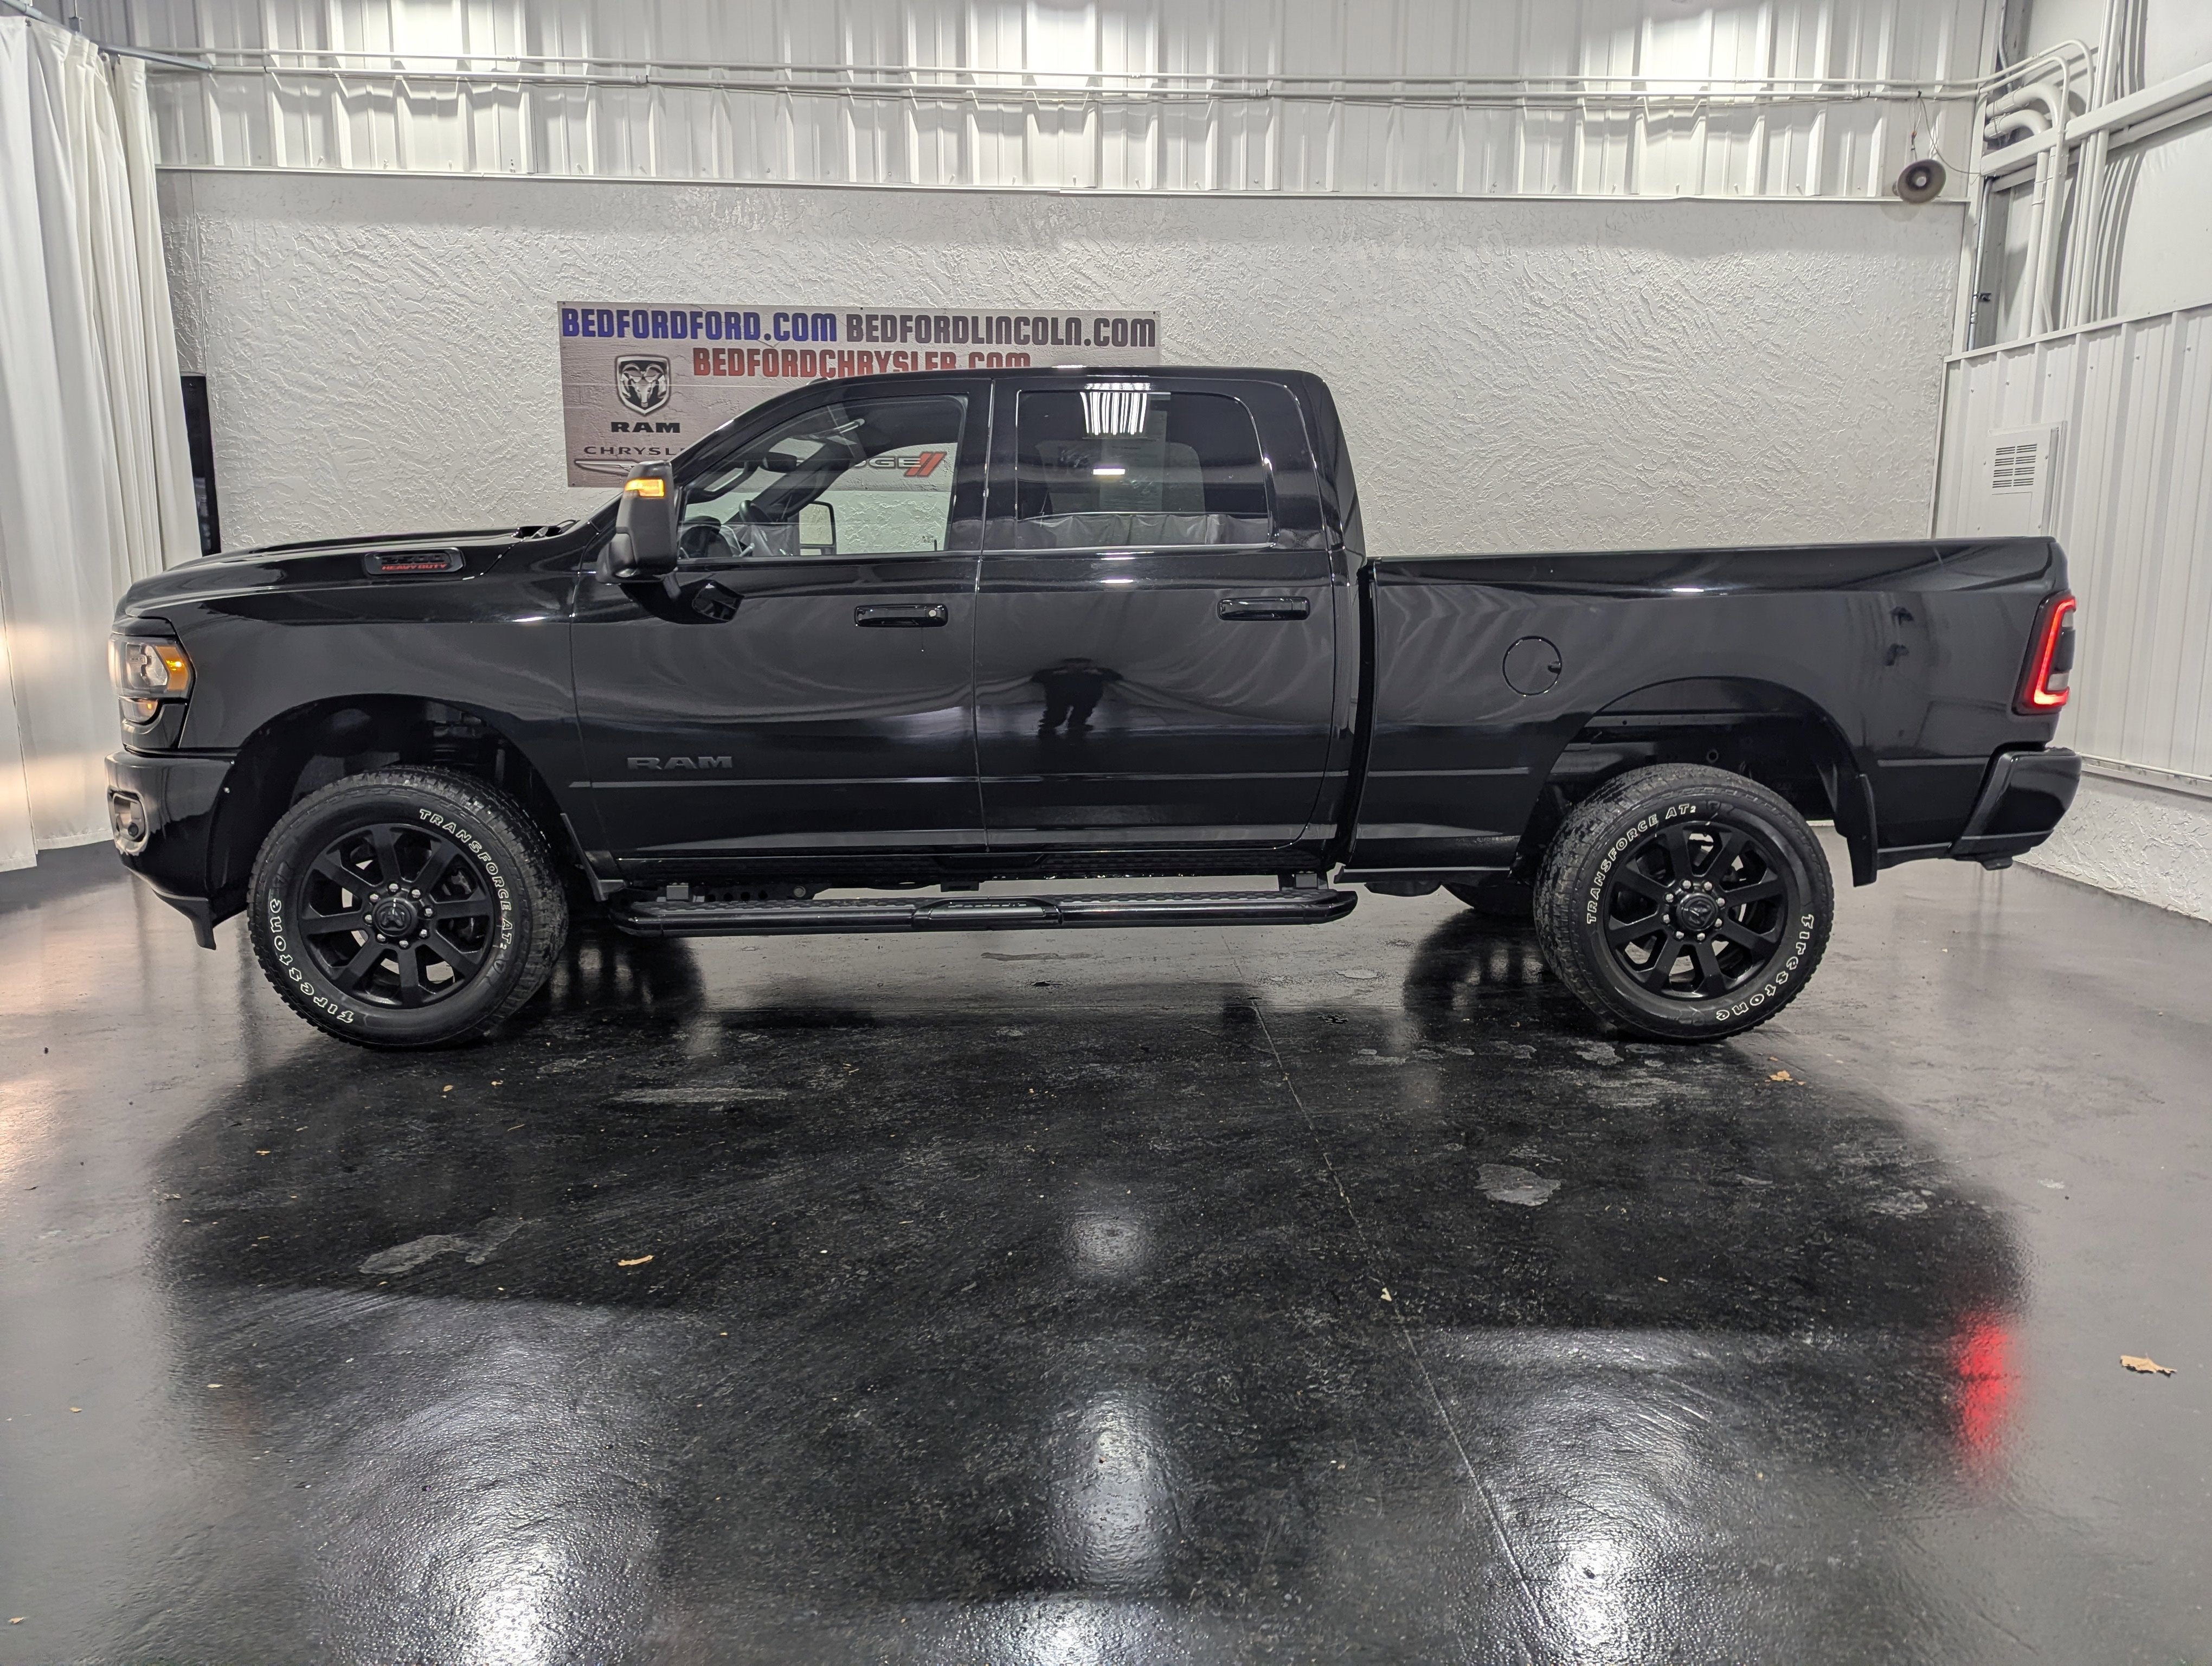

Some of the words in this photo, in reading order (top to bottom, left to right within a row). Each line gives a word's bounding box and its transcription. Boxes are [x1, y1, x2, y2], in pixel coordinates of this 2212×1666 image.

[562, 308, 837, 342] BEDFORDFORD.COM
[846, 313, 1155, 347] BEDFORDLINCOLN.COM
[584, 446, 685, 456] CHRYSL
[611, 421, 680, 433] RAM
[627, 756, 732, 770] RAM
[420, 809, 512, 911] TRANSFORCE
[1586, 813, 1658, 925] TRANSFORCE
[270, 898, 355, 1024] Firestone
[1716, 914, 1814, 1021] Firestone
